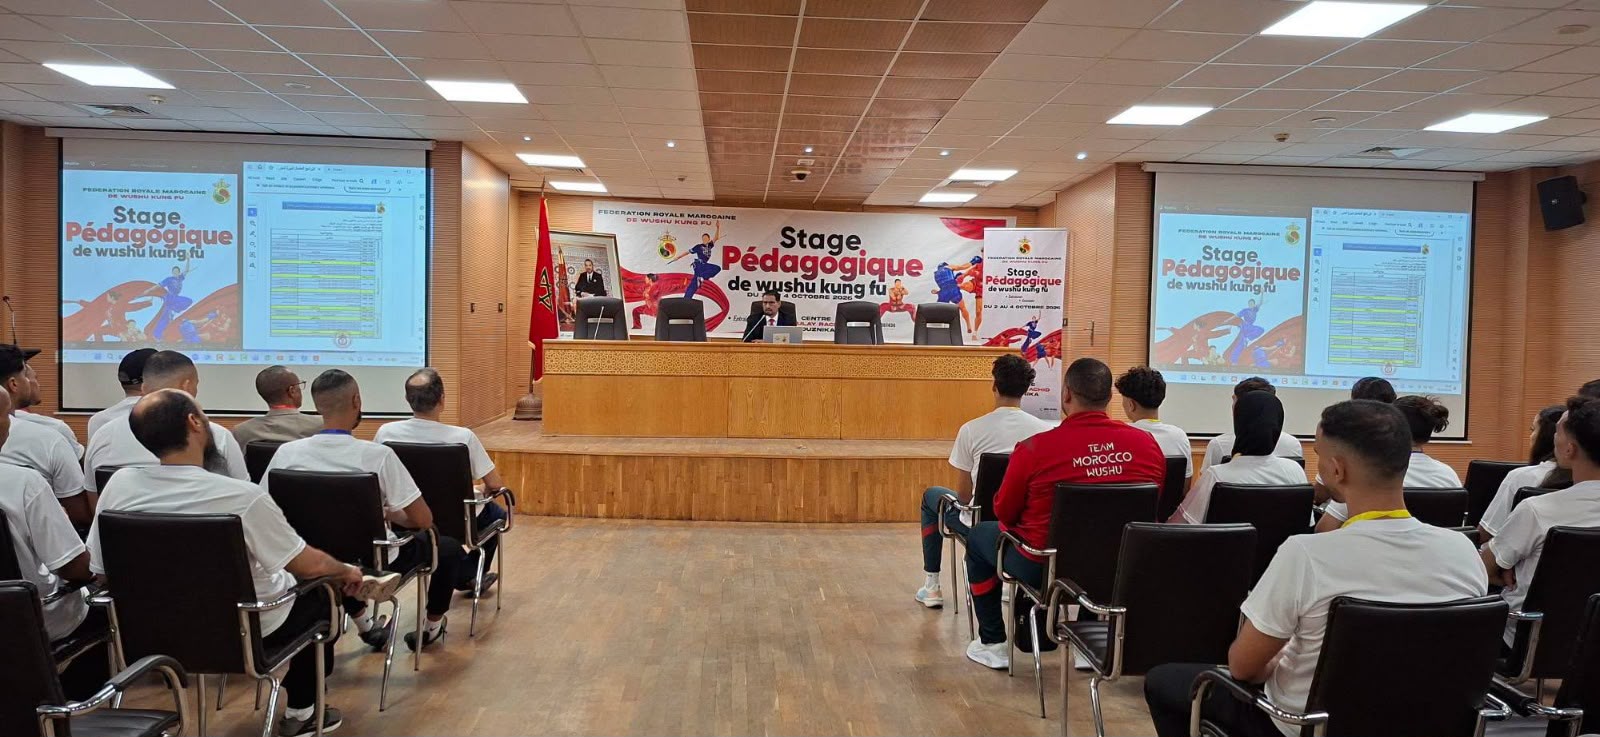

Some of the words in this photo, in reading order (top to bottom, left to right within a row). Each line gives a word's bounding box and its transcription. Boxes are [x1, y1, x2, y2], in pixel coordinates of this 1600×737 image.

[113, 206, 181, 229] Stage
[66, 222, 233, 249] Pédagogique
[780, 226, 862, 256] Stage
[73, 245, 92, 257] de
[96, 246, 146, 258] wushu
[150, 246, 187, 261] kung
[189, 247, 204, 259] fu
[1202, 245, 1258, 266] Stage
[722, 245, 924, 282] Pédagogique
[1007, 268, 1038, 278] Stage
[1162, 259, 1300, 284] Pédagogique
[728, 276, 752, 291] de
[756, 278, 815, 294] wushu
[820, 279, 865, 299] kung
[869, 280, 887, 296] fu
[985, 276, 1062, 288] Pédagogique
[1167, 279, 1183, 289] de
[1186, 280, 1228, 291] wushu
[1229, 280, 1262, 296] kung
[1263, 281, 1276, 293] fu
[1088, 442, 1114, 453] TEAM
[1072, 452, 1132, 468] MOROCCO
[1086, 465, 1122, 477] WUSHU
